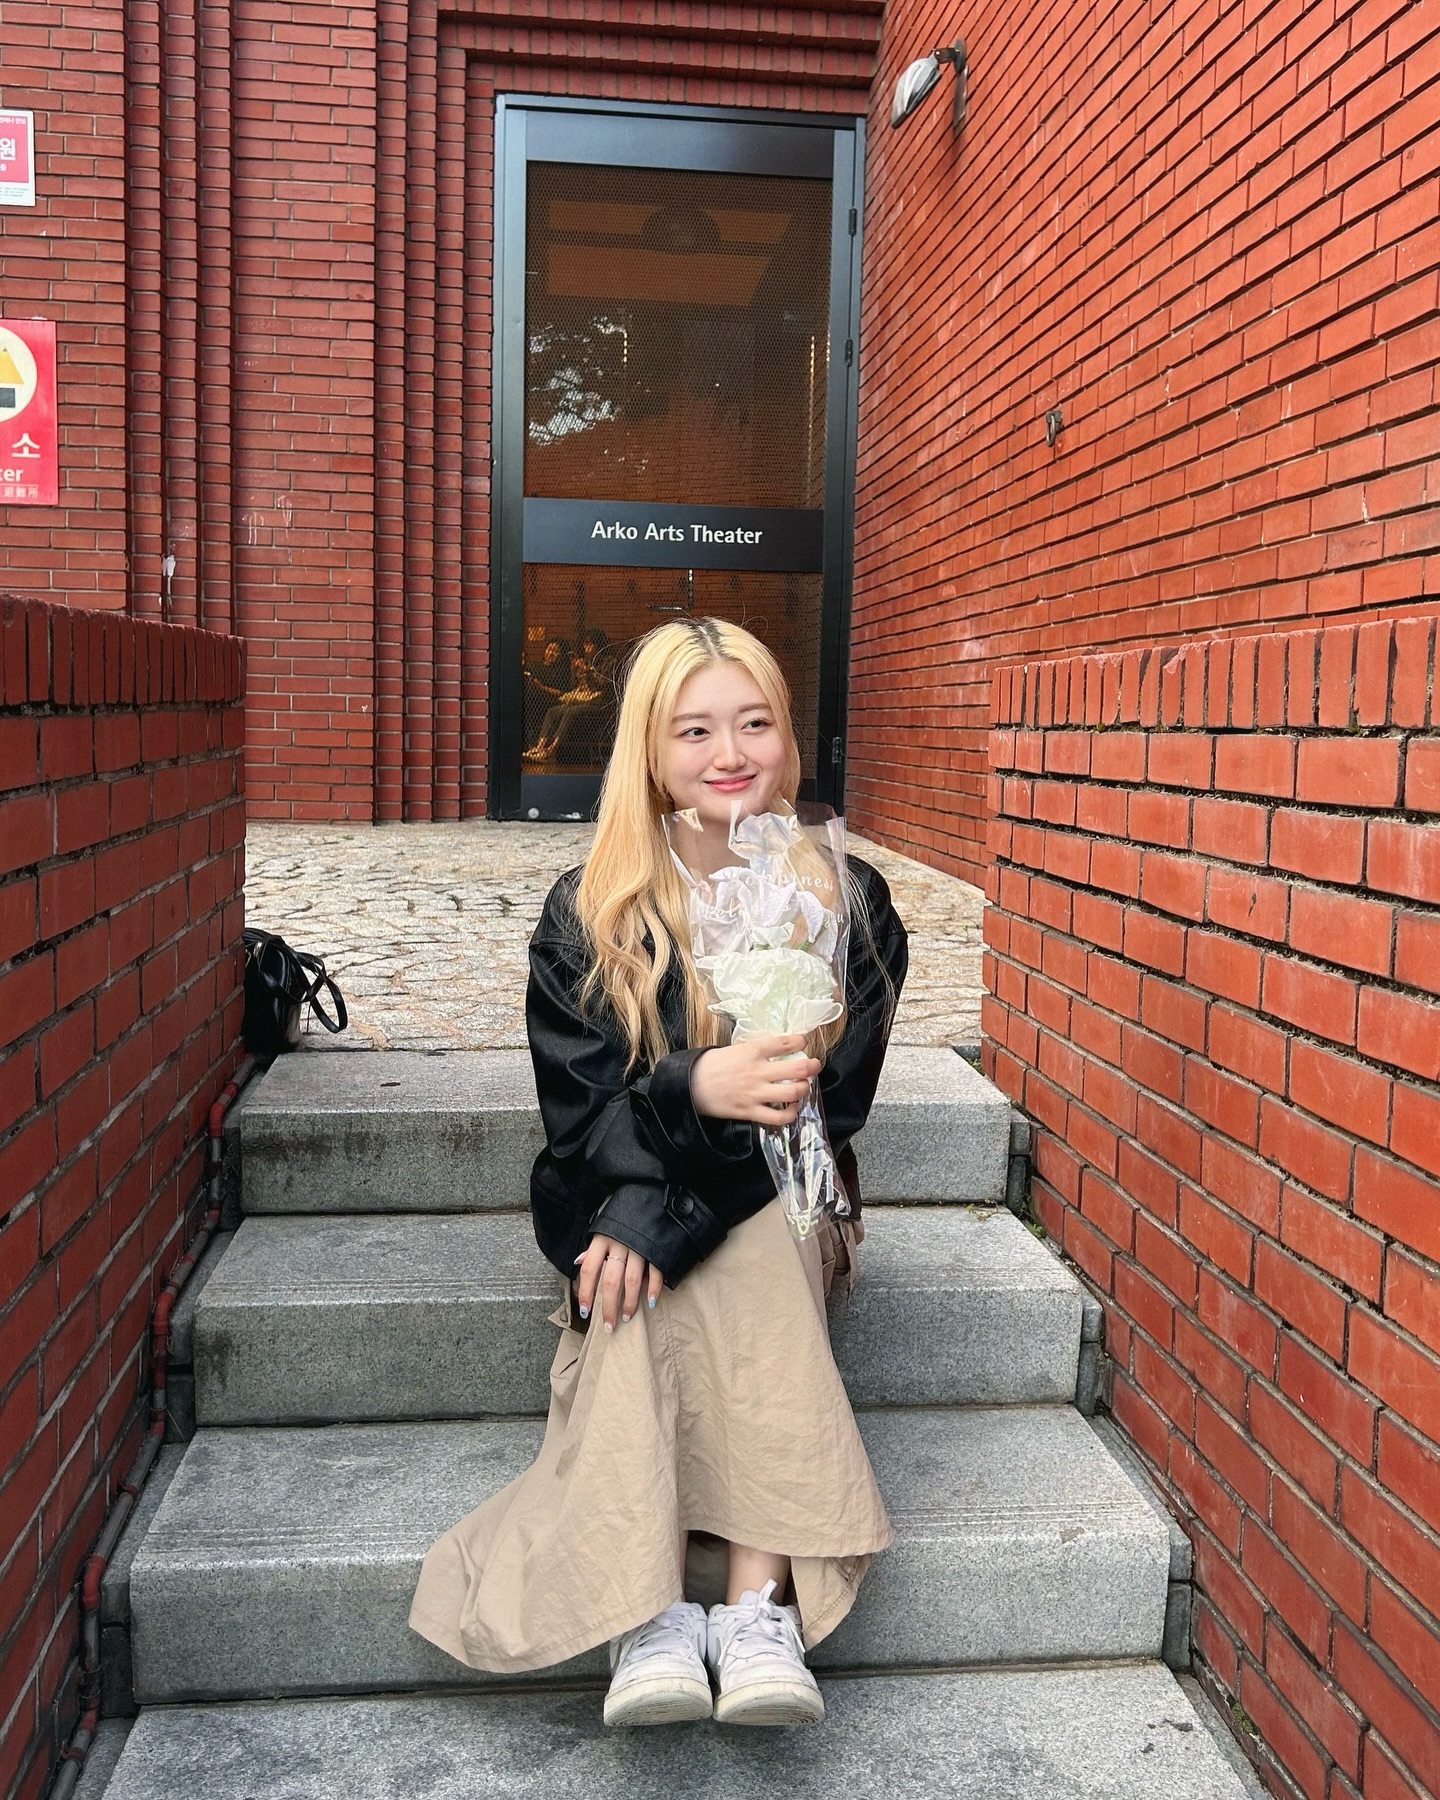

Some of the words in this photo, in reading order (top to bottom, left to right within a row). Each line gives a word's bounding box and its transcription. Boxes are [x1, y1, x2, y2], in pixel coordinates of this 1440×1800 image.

[12, 432, 40, 458] 소
[591, 520, 638, 540] Arko
[644, 523, 685, 542] Arts
[690, 524, 763, 544] Theater
